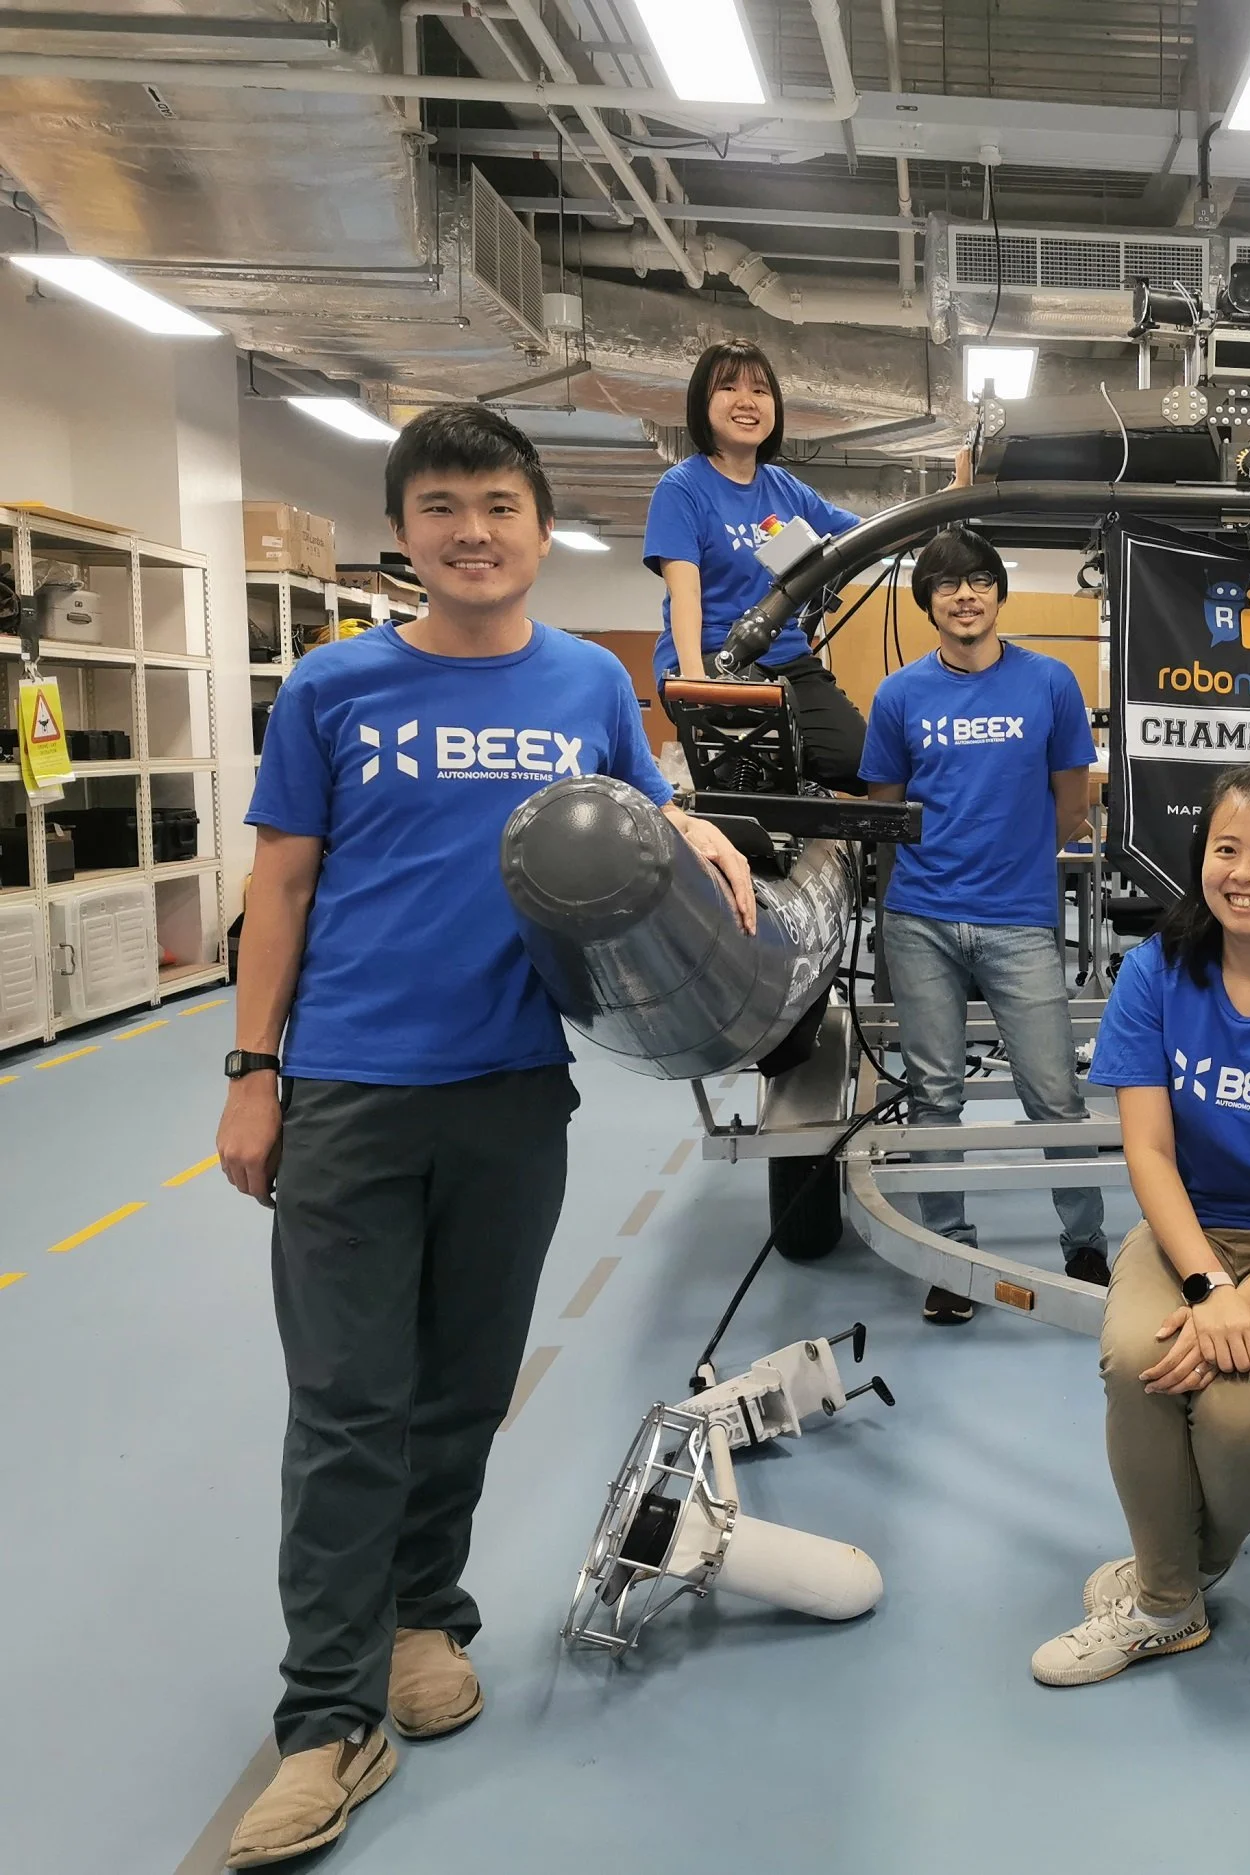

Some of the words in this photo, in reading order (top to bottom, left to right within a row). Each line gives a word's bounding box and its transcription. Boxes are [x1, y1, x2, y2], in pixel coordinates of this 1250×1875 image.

[1215, 606, 1233, 629] R
[953, 716, 1024, 740] BEEX
[436, 726, 582, 775] BEEX
[437, 770, 509, 780] AUTONOMOUS
[511, 772, 553, 782] SYSTEMS
